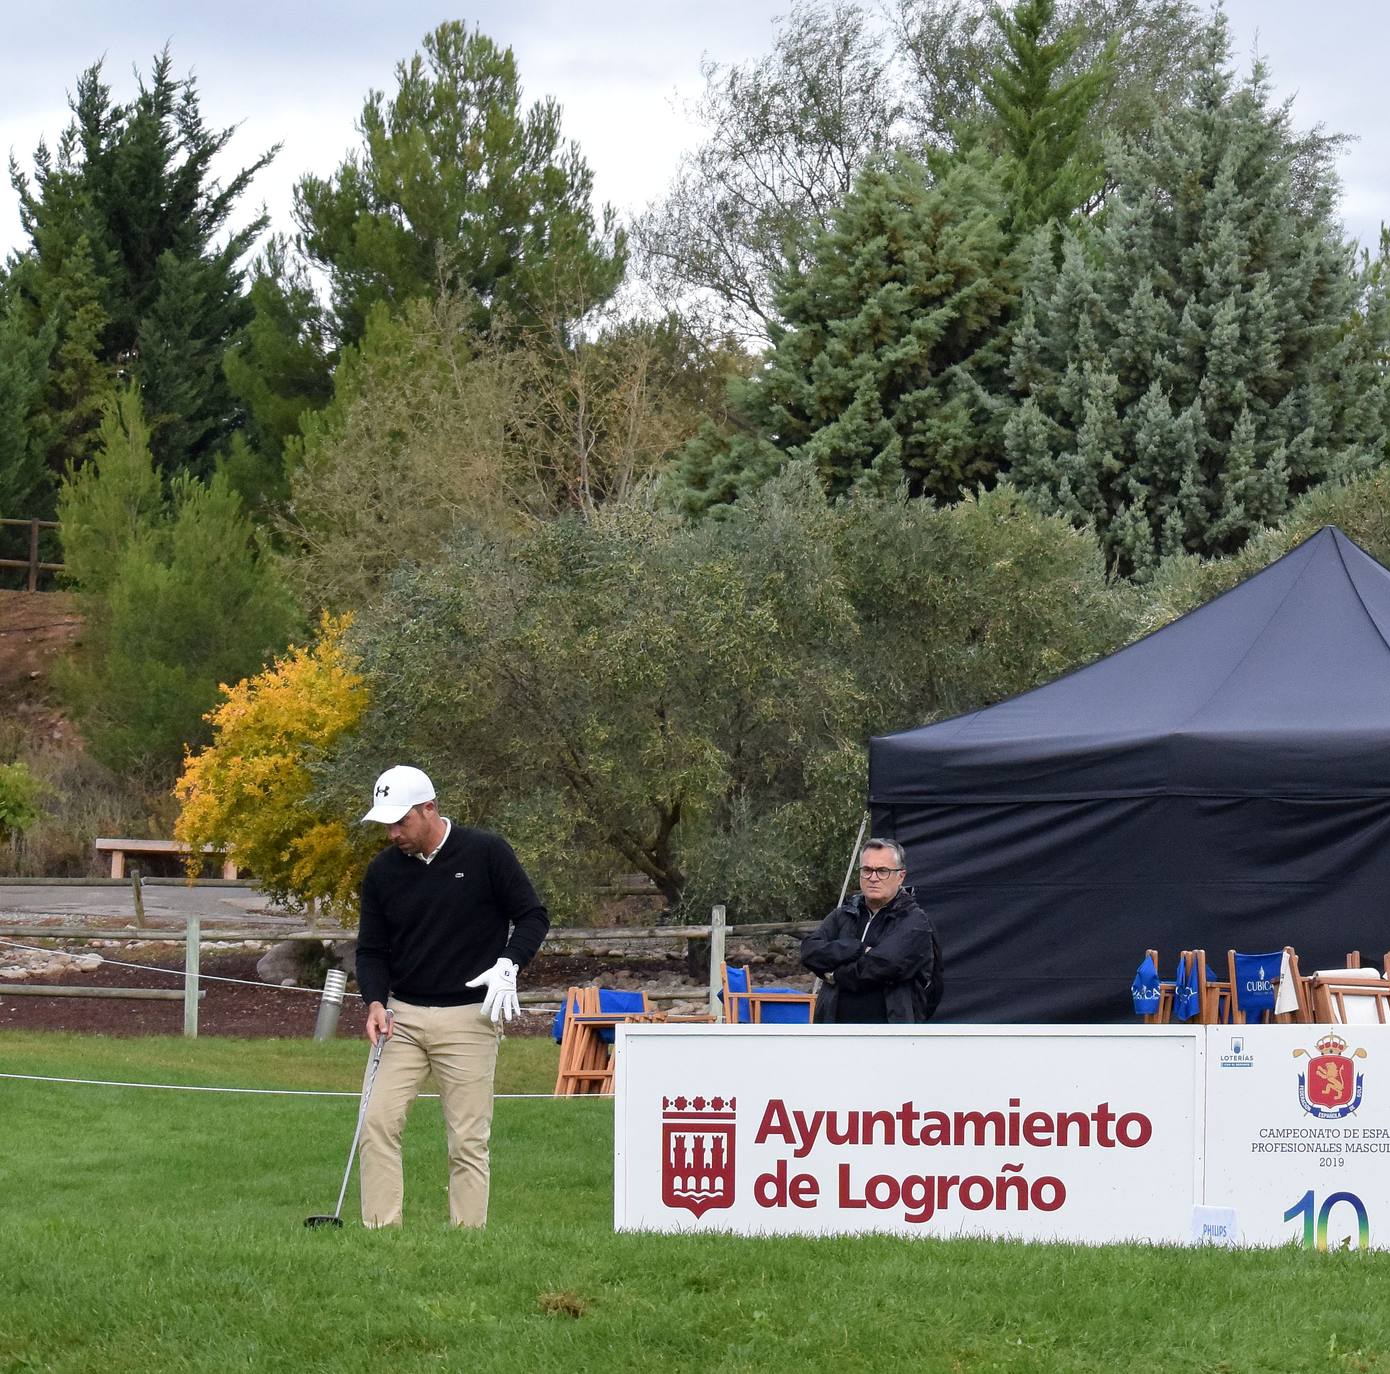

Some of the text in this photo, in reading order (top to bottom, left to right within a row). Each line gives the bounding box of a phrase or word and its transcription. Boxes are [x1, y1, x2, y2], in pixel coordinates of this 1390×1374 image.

[753, 1097, 1154, 1158] Ayuntamiento
[1258, 1128, 1341, 1139] CAMPEONATO
[1343, 1128, 1359, 1139] DE
[1251, 1143, 1342, 1154] PROFESIONALES
[1319, 1157, 1345, 1168] 2019
[753, 1159, 1067, 1223] de Logroño
[1283, 1189, 1370, 1252] 10
[1203, 1224, 1227, 1238] PHILIPS
